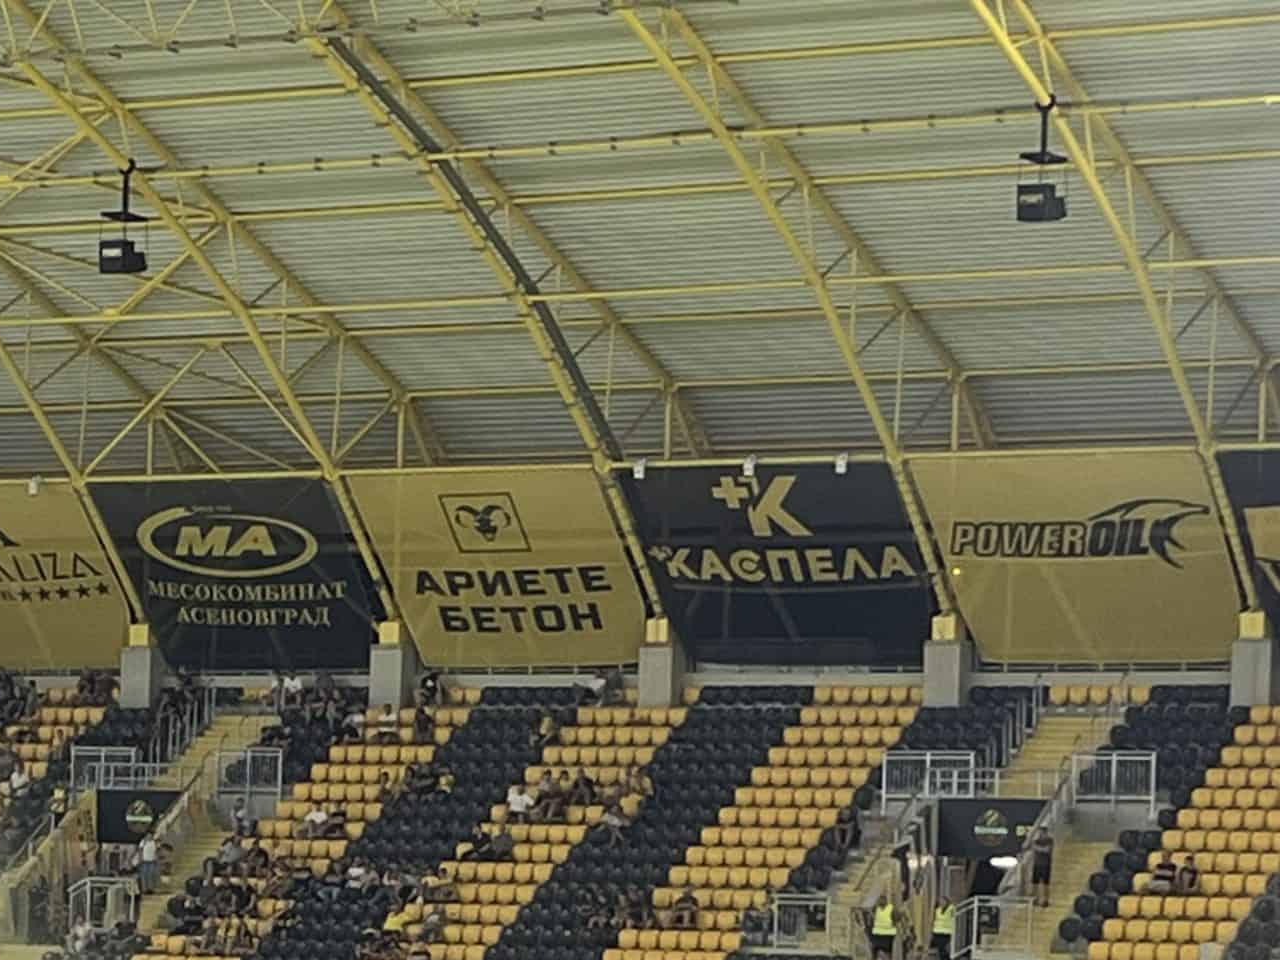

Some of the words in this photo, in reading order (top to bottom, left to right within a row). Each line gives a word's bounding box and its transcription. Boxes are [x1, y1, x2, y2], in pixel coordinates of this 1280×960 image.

[176, 525, 277, 557] MA
[666, 546, 917, 582] КАСПЕЛА
[147, 580, 347, 602] МЕСОКОМБИНАТ
[417, 565, 613, 598] АРИЕТЕ
[176, 606, 332, 628] АСЕНОВГРАД
[440, 602, 604, 634] БЕТОН
